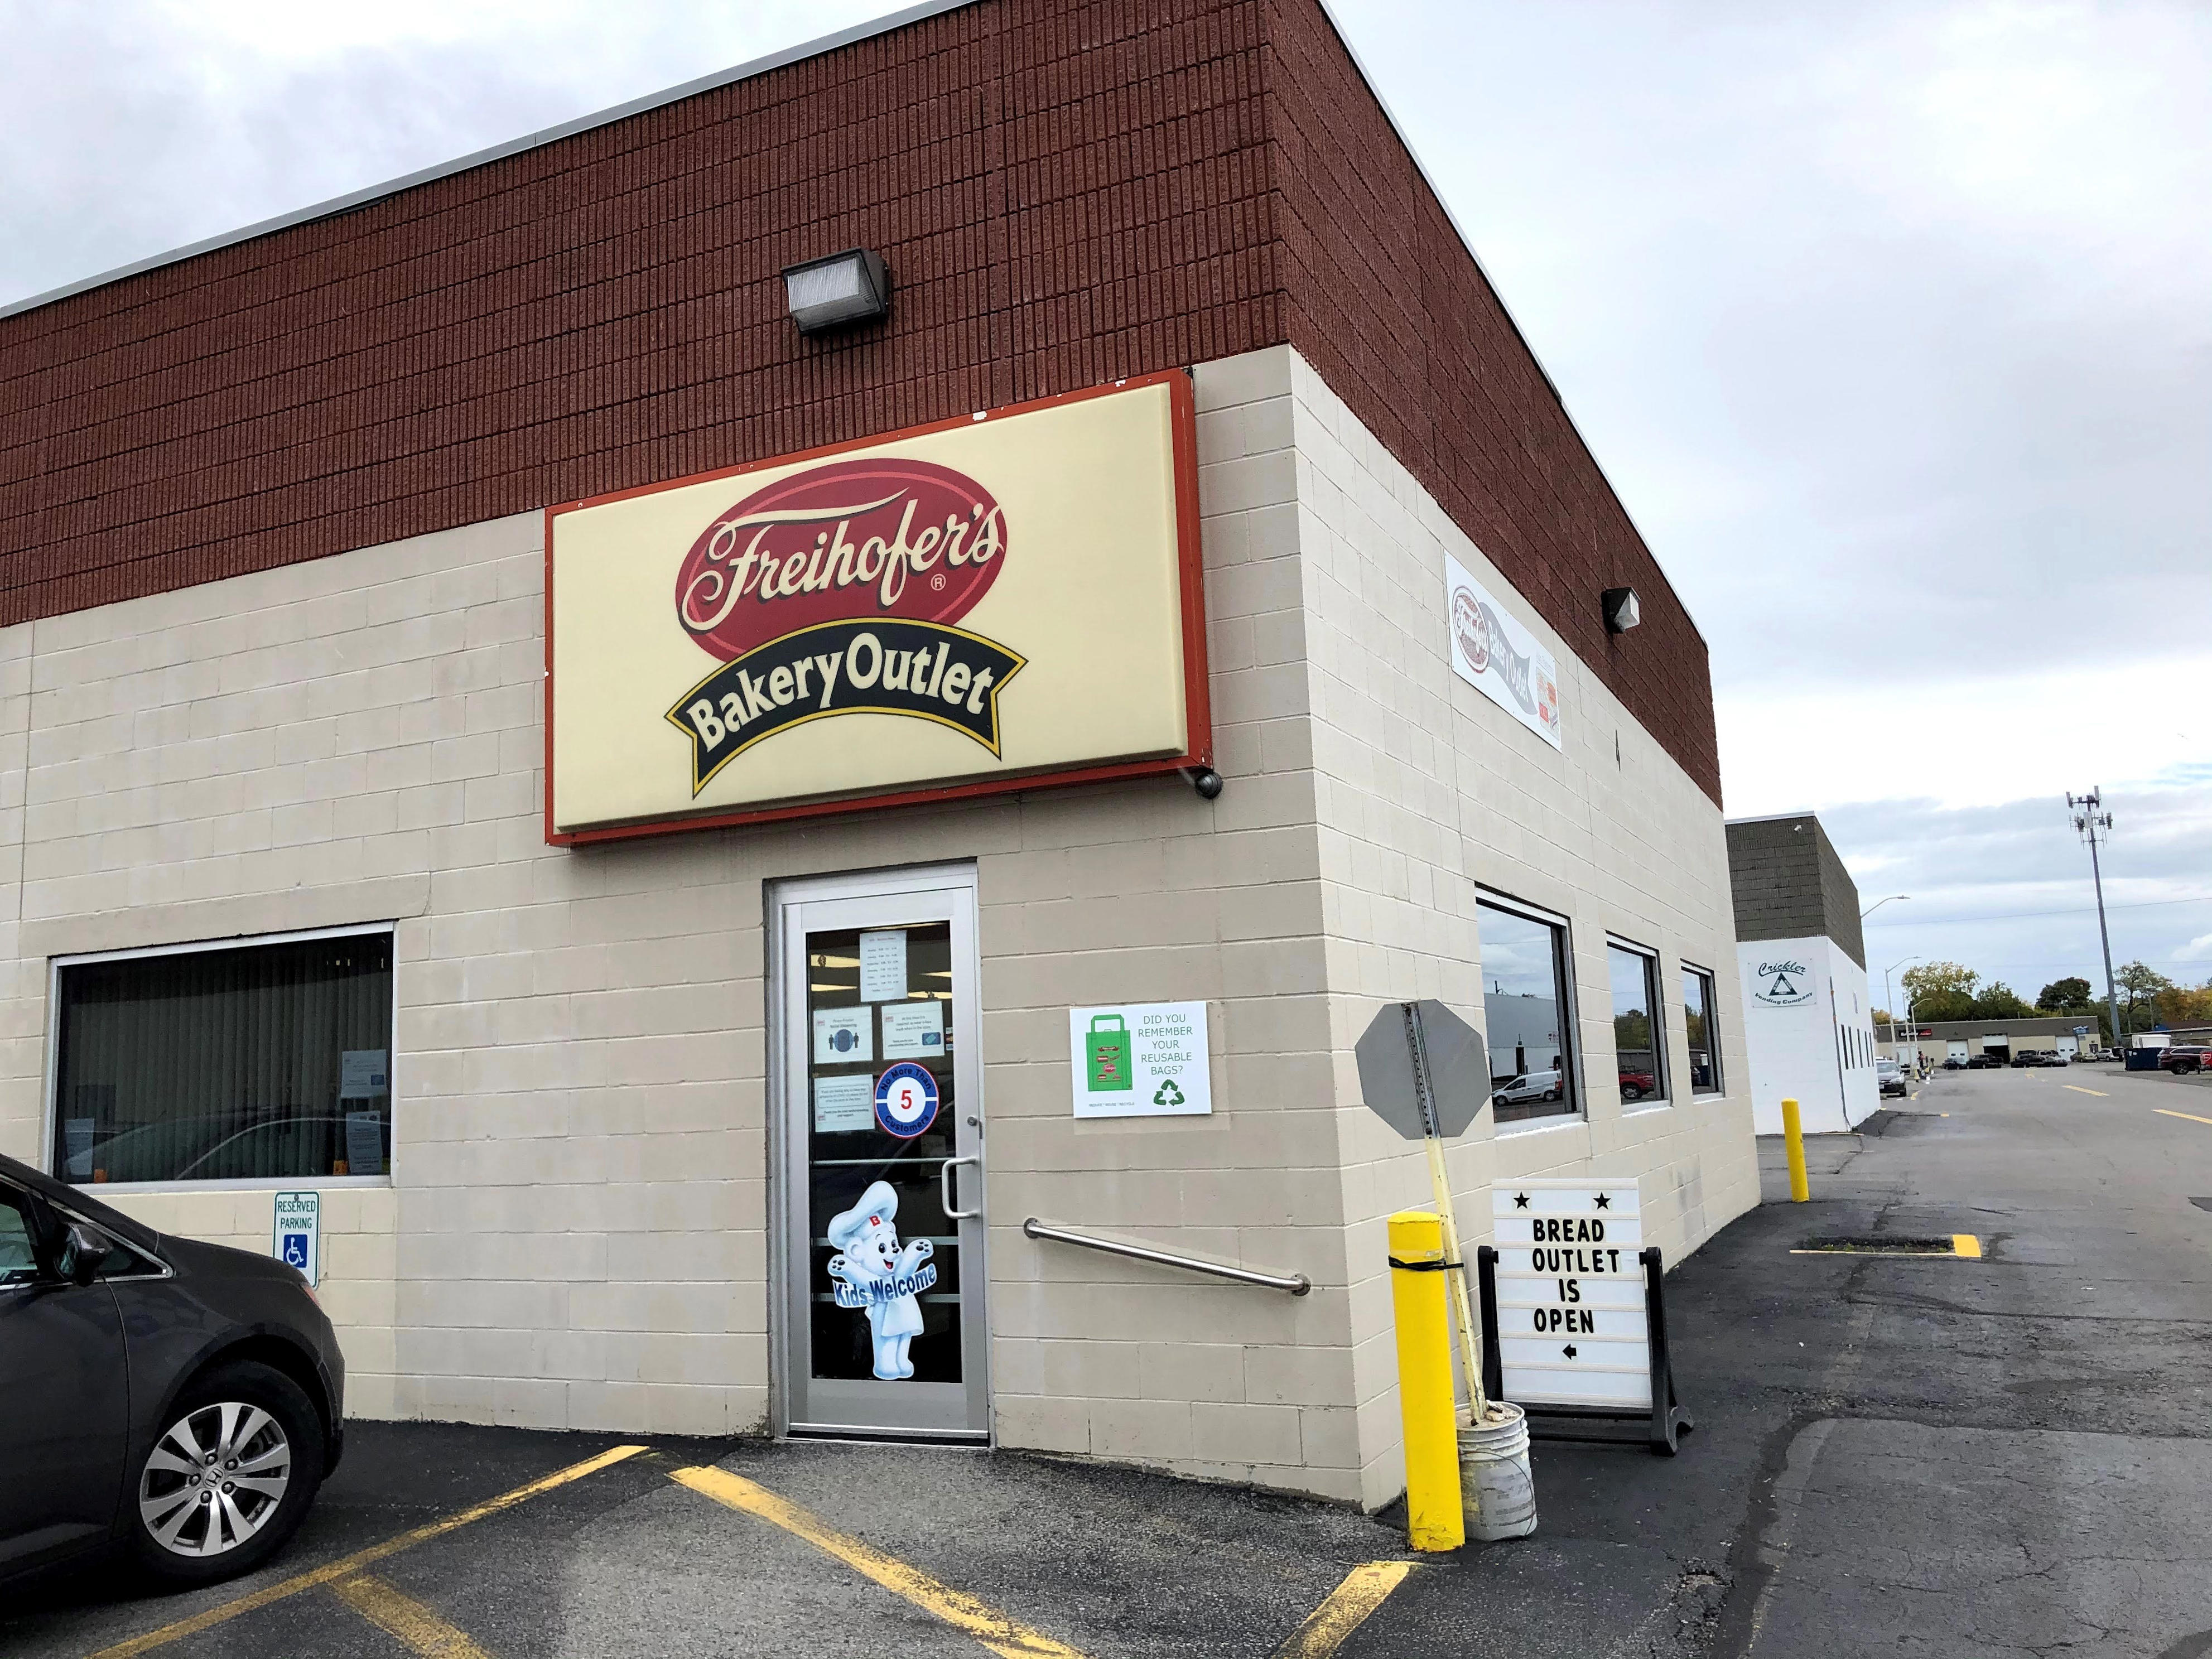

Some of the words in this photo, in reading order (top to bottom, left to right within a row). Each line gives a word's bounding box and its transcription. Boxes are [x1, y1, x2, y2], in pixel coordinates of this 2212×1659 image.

[681, 486, 1004, 630] Freihofer's
[686, 649, 844, 752] Bakery
[847, 632, 994, 714] Outlet
[1758, 961, 1806, 977] Crickler
[1755, 992, 1781, 1005] Vending
[1782, 992, 1813, 1004] Company
[1144, 1016, 1162, 1025] DID
[1165, 1014, 1186, 1023] YOU
[1138, 1026, 1193, 1038] REMEMBER
[1152, 1040, 1180, 1049] YOUR
[1141, 1052, 1192, 1063] REUSABLE
[1151, 1065, 1183, 1076] BAGS?
[880, 1079, 891, 1091] No
[891, 1068, 912, 1078] More
[915, 1069, 932, 1089] Than
[901, 1089, 912, 1110] 5
[885, 1116, 929, 1132] Customers
[278, 1200, 316, 1212] RESERVED
[281, 1217, 312, 1229] PARKING
[1533, 1219, 1604, 1242] BREAD
[1533, 1248, 1619, 1272] OUTLET
[834, 1281, 866, 1306] Kids
[869, 1264, 936, 1302] Welcome
[1559, 1279, 1580, 1303] IS
[1534, 1308, 1594, 1333] OPEN
